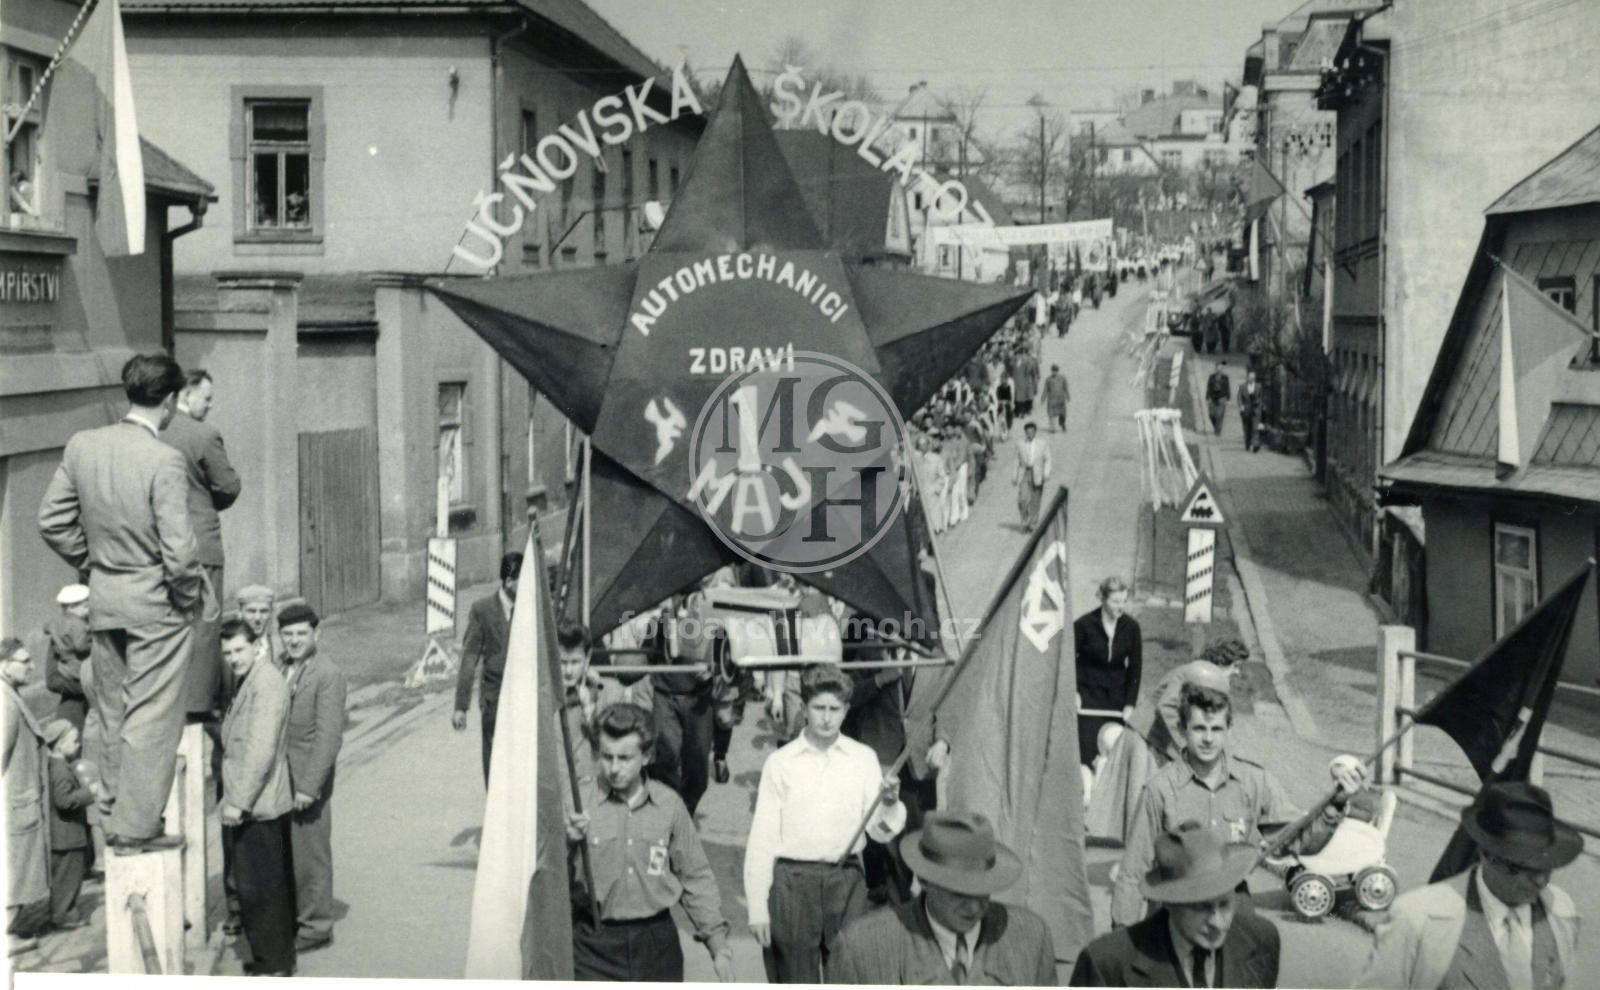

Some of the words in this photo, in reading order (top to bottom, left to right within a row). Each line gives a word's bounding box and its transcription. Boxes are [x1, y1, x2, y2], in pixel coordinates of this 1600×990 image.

[452, 62, 704, 270] UČŇOVSKÁ
[769, 65, 917, 186] ŠKOLA
[630, 252, 849, 336] AUTOMECHANICI
[689, 342, 795, 374] ZDRAVÍ
